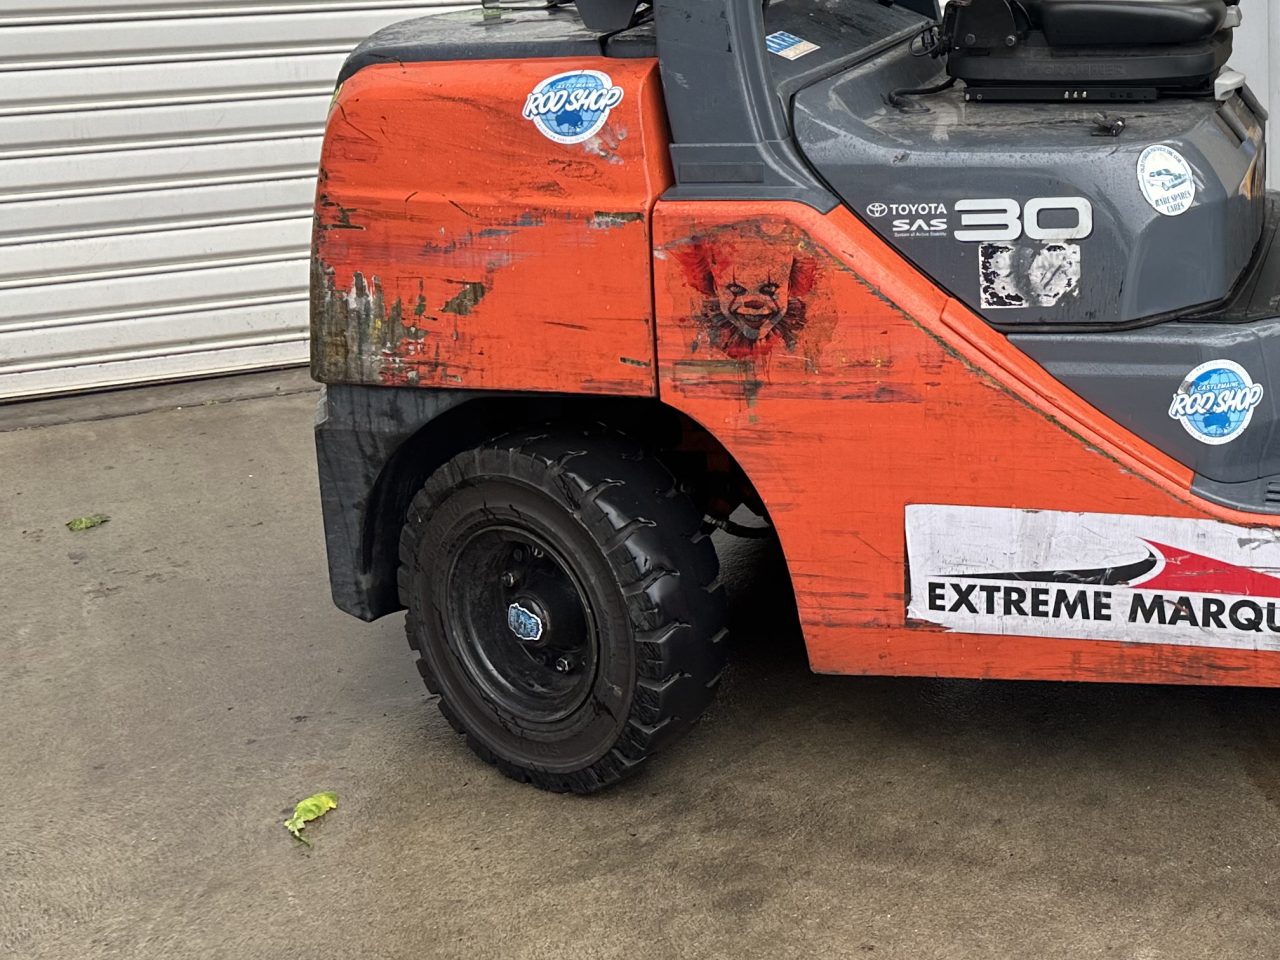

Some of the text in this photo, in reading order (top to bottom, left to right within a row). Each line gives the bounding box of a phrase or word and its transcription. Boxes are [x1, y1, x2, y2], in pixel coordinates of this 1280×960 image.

[525, 87, 621, 117] ROD SHOP
[889, 202, 948, 216] TOYOTA
[953, 197, 1094, 242] 30
[892, 218, 948, 232] SAS
[1170, 385, 1261, 415] ROD SHOP
[928, 581, 1112, 622] EXTREME
